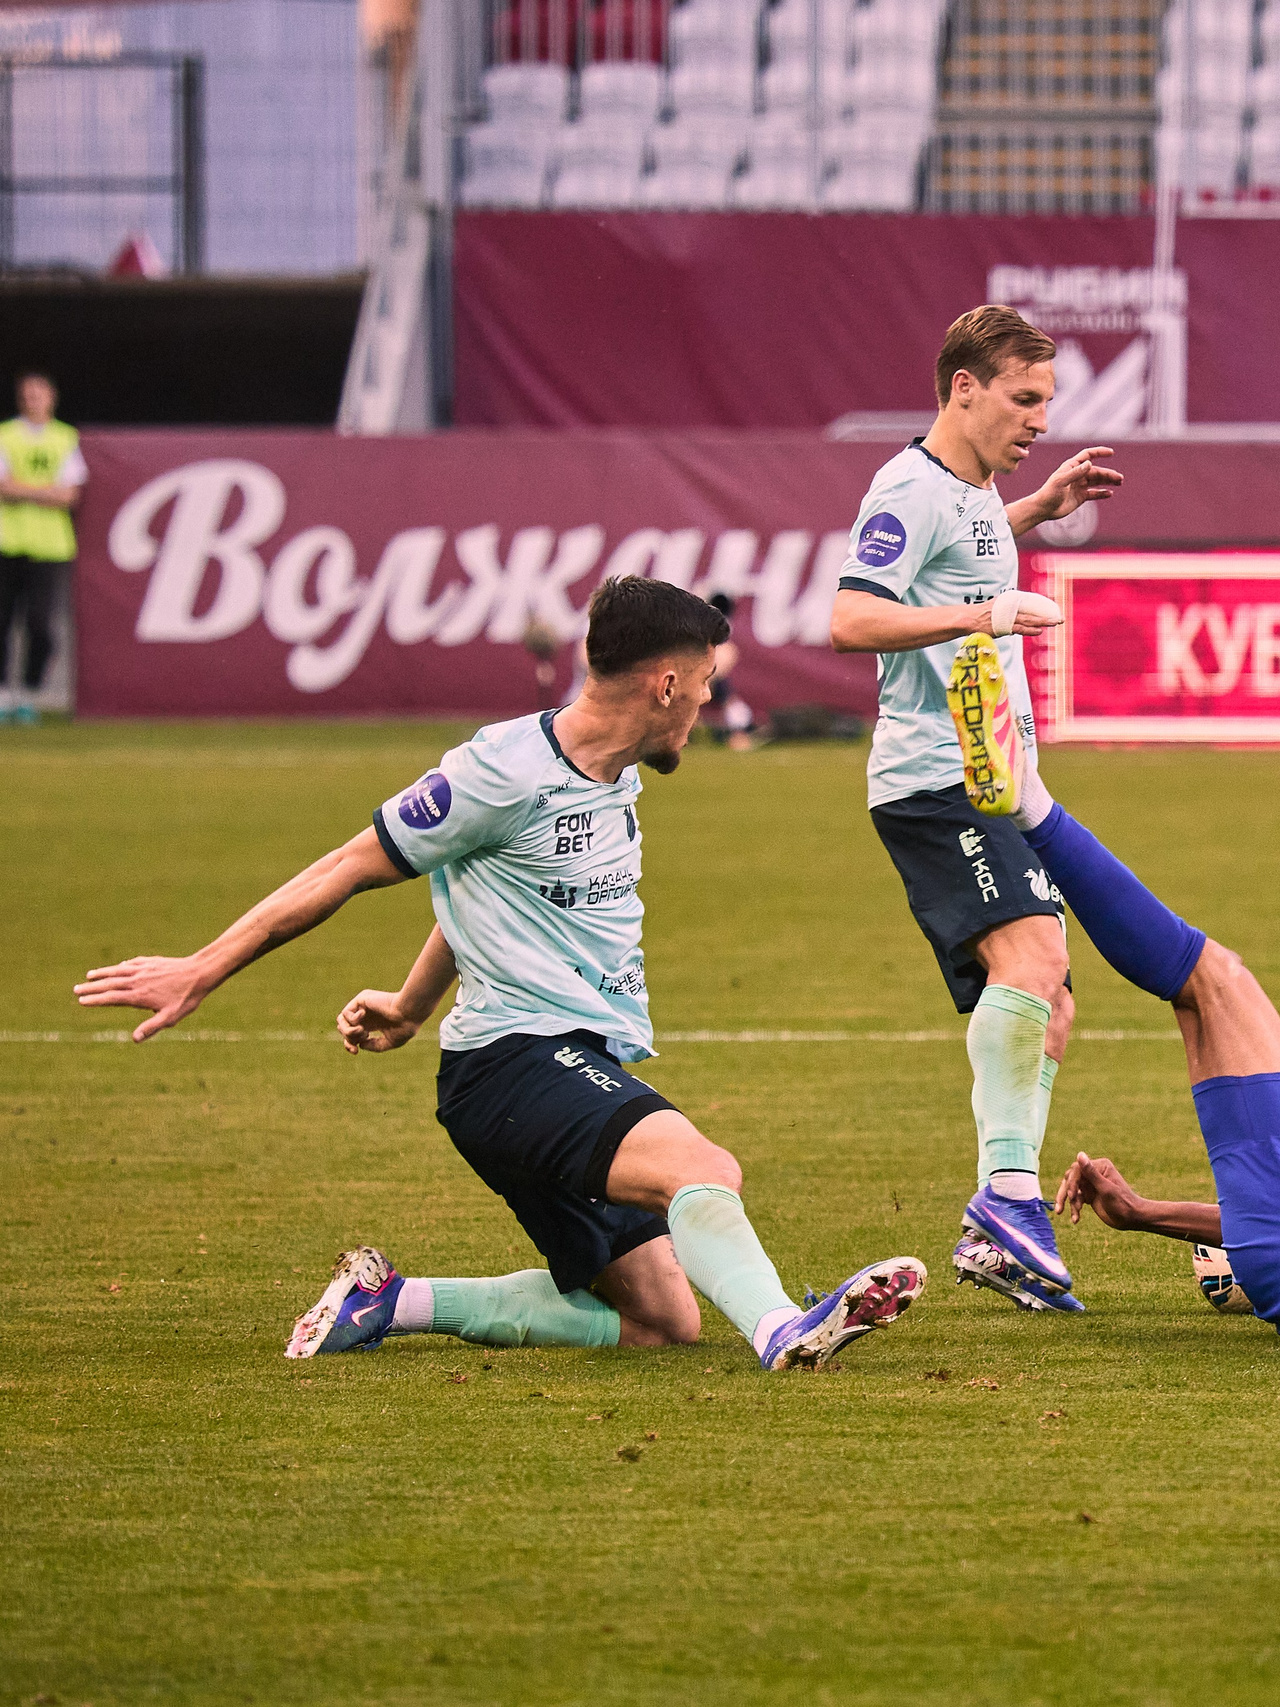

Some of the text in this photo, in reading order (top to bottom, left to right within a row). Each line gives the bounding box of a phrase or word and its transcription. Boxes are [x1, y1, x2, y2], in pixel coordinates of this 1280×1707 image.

[873, 530, 902, 544] МИР
[554, 811, 593, 834] FON
[555, 832, 595, 855] BET
